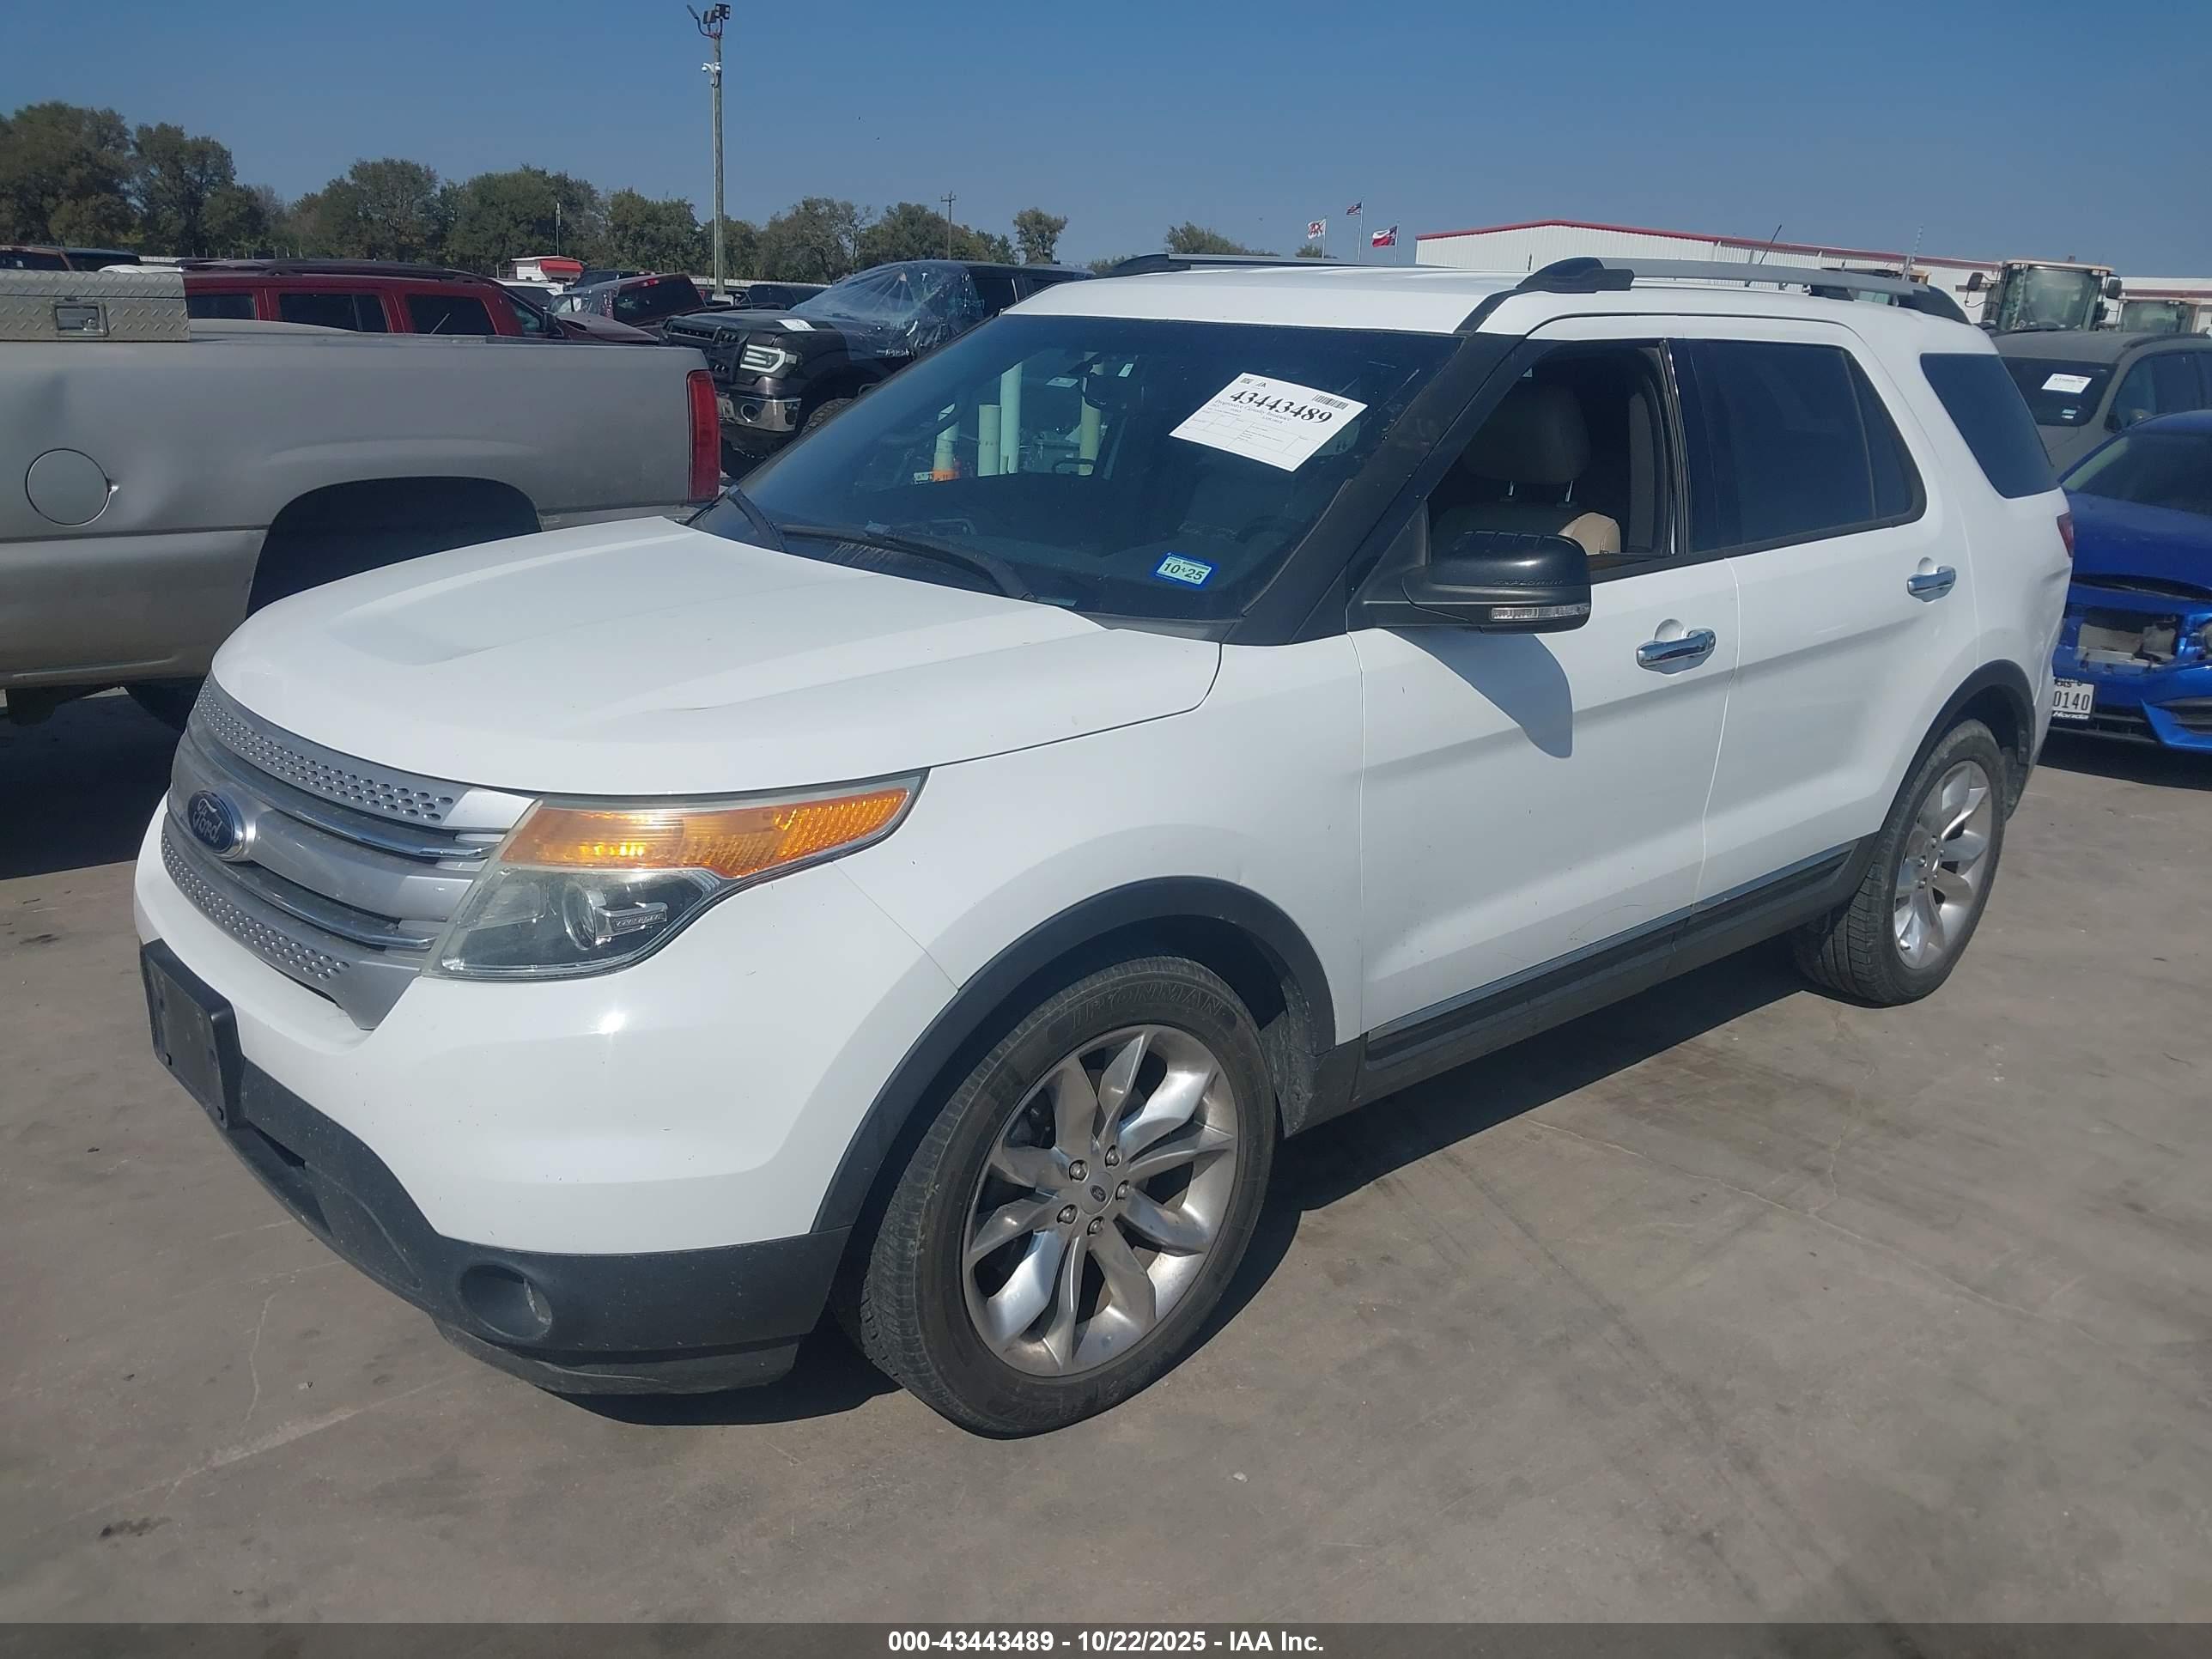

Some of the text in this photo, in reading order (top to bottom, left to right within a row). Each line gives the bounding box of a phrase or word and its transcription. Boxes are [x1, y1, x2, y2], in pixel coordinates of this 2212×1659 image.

[1230, 391, 1333, 423] 43443489
[1164, 562, 1181, 574] 10
[1184, 568, 1205, 580] 25
[2053, 690, 2090, 711] 0140
[193, 799, 223, 842] Ford
